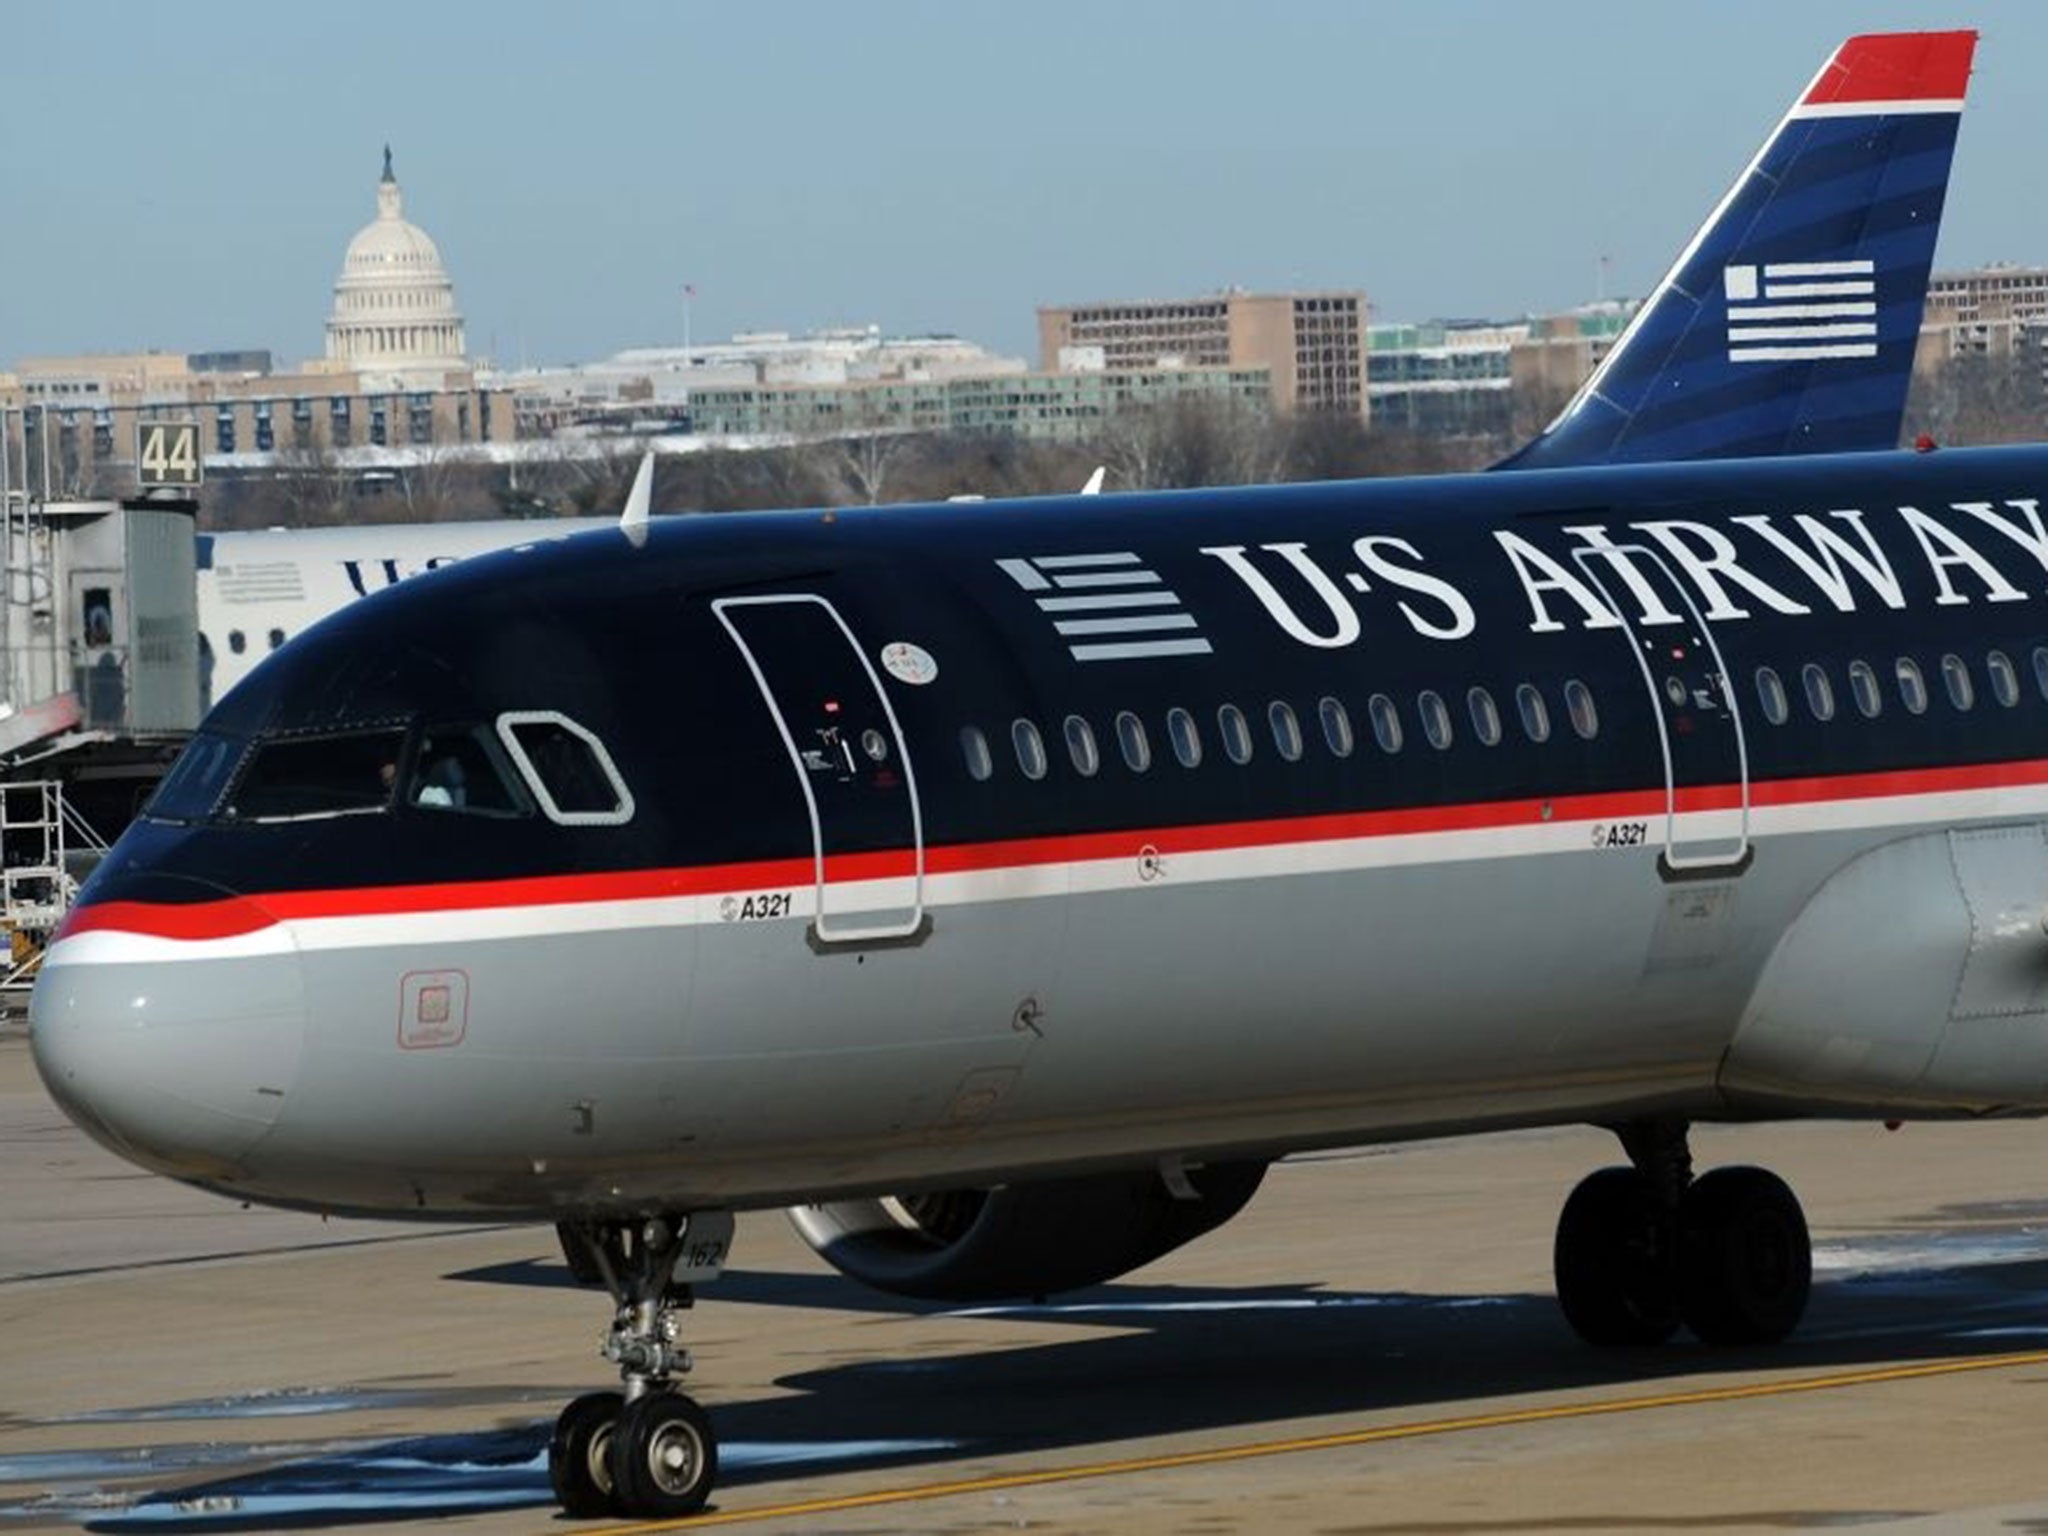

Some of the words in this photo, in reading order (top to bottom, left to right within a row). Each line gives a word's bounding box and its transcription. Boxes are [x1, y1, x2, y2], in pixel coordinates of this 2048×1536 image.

[142, 427, 197, 481] 44
[1606, 822, 1648, 847] A321
[740, 892, 792, 919] A321
[687, 1242, 723, 1269] 162
